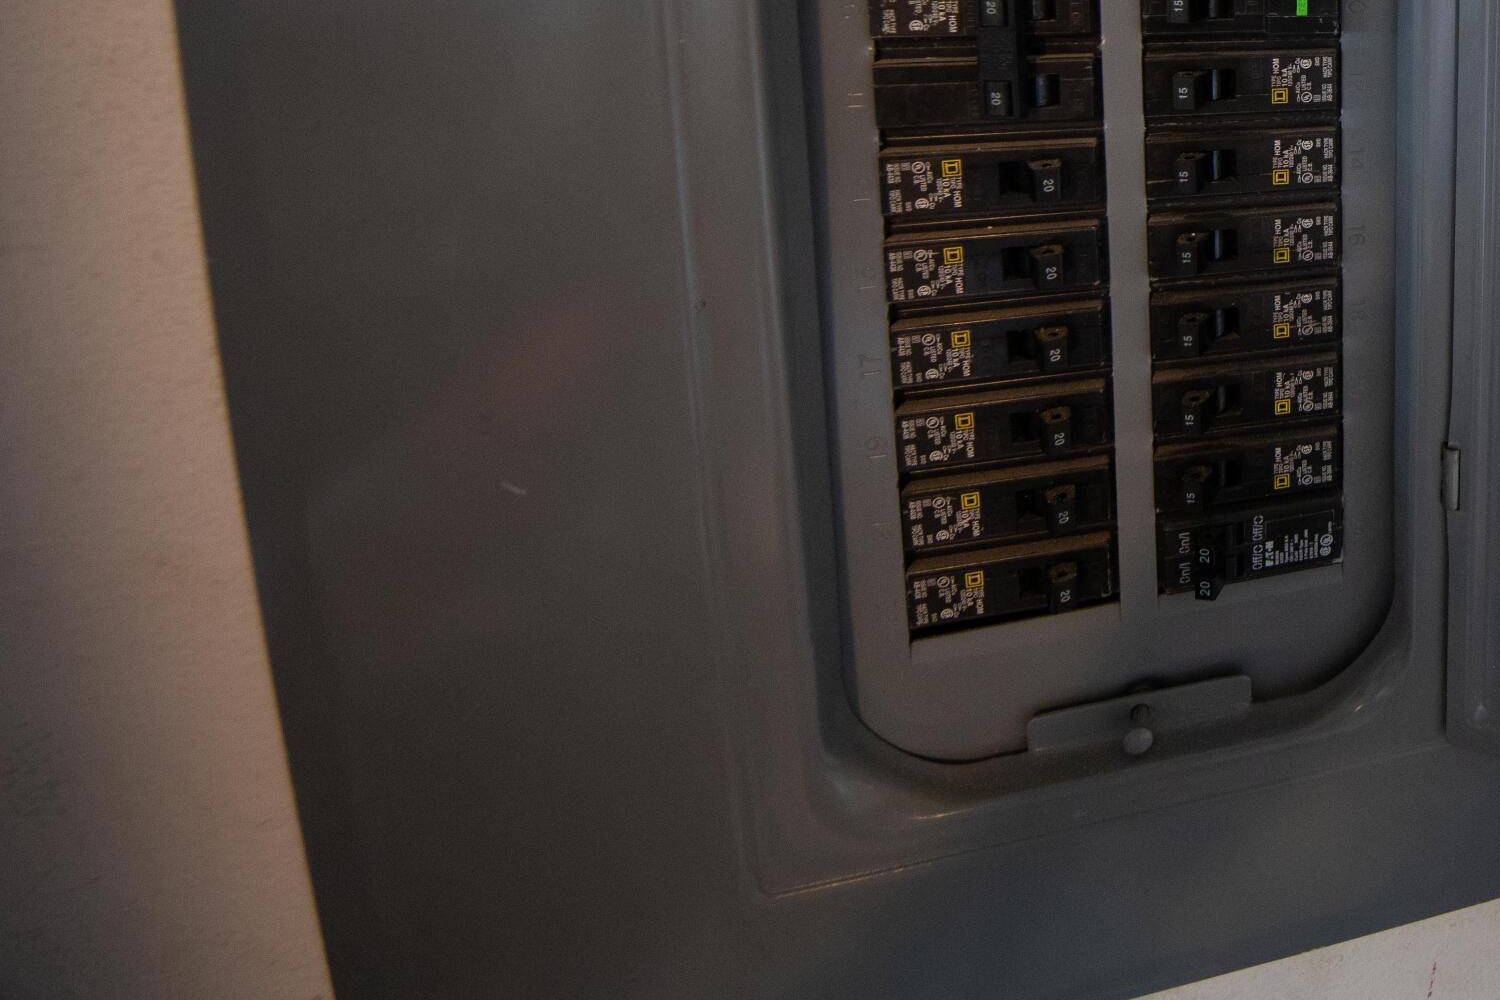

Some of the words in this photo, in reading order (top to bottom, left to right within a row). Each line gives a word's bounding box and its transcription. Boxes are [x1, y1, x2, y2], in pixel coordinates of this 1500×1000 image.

[986, 0, 997, 15] 20
[1173, 0, 1184, 13] 15
[948, 15, 957, 32] HOM
[1272, 58, 1280, 74] HOM
[991, 91, 1001, 106] 20
[1178, 87, 1188, 100] 15
[1179, 170, 1189, 183] 15
[1042, 178, 1055, 193] 20
[1182, 251, 1192, 264] 15
[1045, 266, 1058, 281] 20
[1183, 335, 1193, 347] 15
[1049, 348, 1061, 363] 20
[1185, 413, 1194, 426] 15
[1053, 431, 1065, 446] 20
[1186, 491, 1196, 504] 15
[1058, 510, 1069, 525] 20
[1199, 547, 1210, 564] 20
[1199, 580, 1211, 597] 20
[1060, 589, 1071, 604] 20
